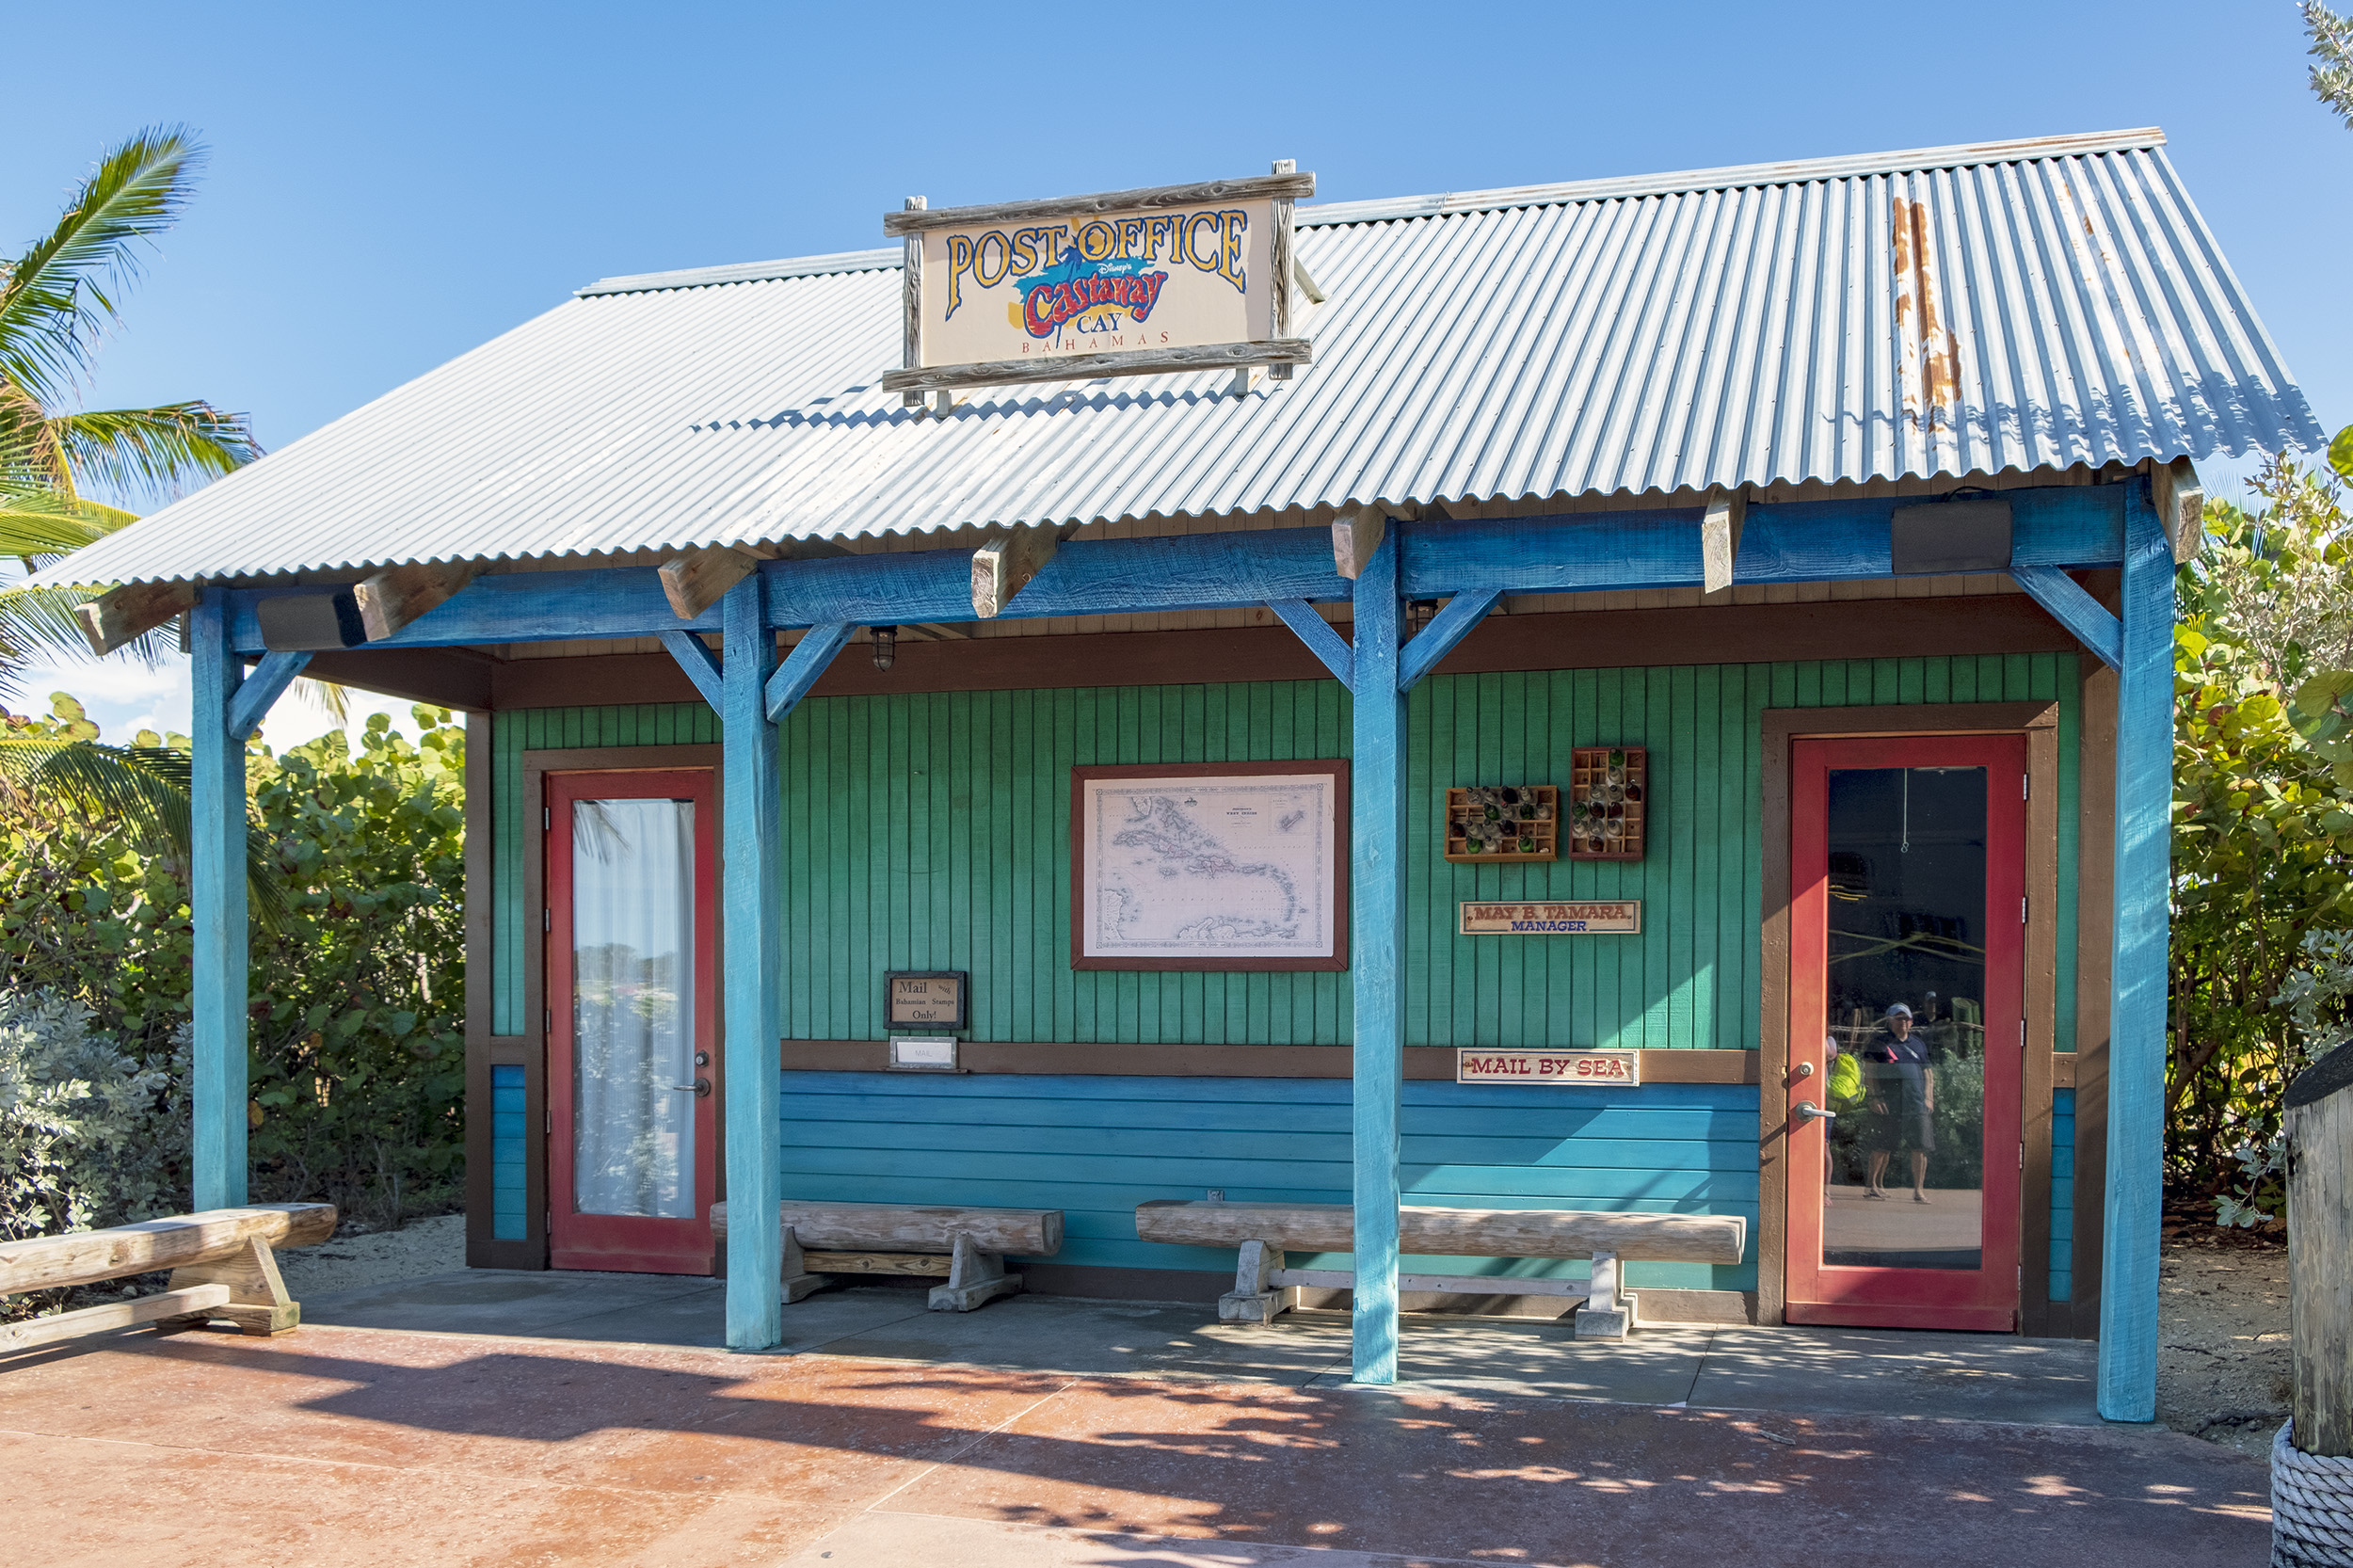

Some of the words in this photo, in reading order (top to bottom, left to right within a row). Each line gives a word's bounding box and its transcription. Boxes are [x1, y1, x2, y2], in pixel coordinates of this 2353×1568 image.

[945, 224, 1068, 322] POST
[1078, 209, 1248, 294] OFFICE
[1023, 271, 1168, 339] Castaway
[1076, 312, 1123, 333] CAY
[1022, 331, 1169, 354] BAHAMAS
[1474, 906, 1517, 920] MAY
[1522, 906, 1538, 920] B.
[1544, 905, 1626, 920] TAMARA
[1511, 920, 1587, 932] MANAGER
[898, 982, 927, 993] Mail
[938, 984, 951, 995] with
[932, 998, 954, 1006] Stamps
[912, 1010, 936, 1021] Only!
[1471, 1058, 1531, 1075] MAIL
[1539, 1059, 1570, 1075] BY
[1577, 1060, 1625, 1076] SEA
